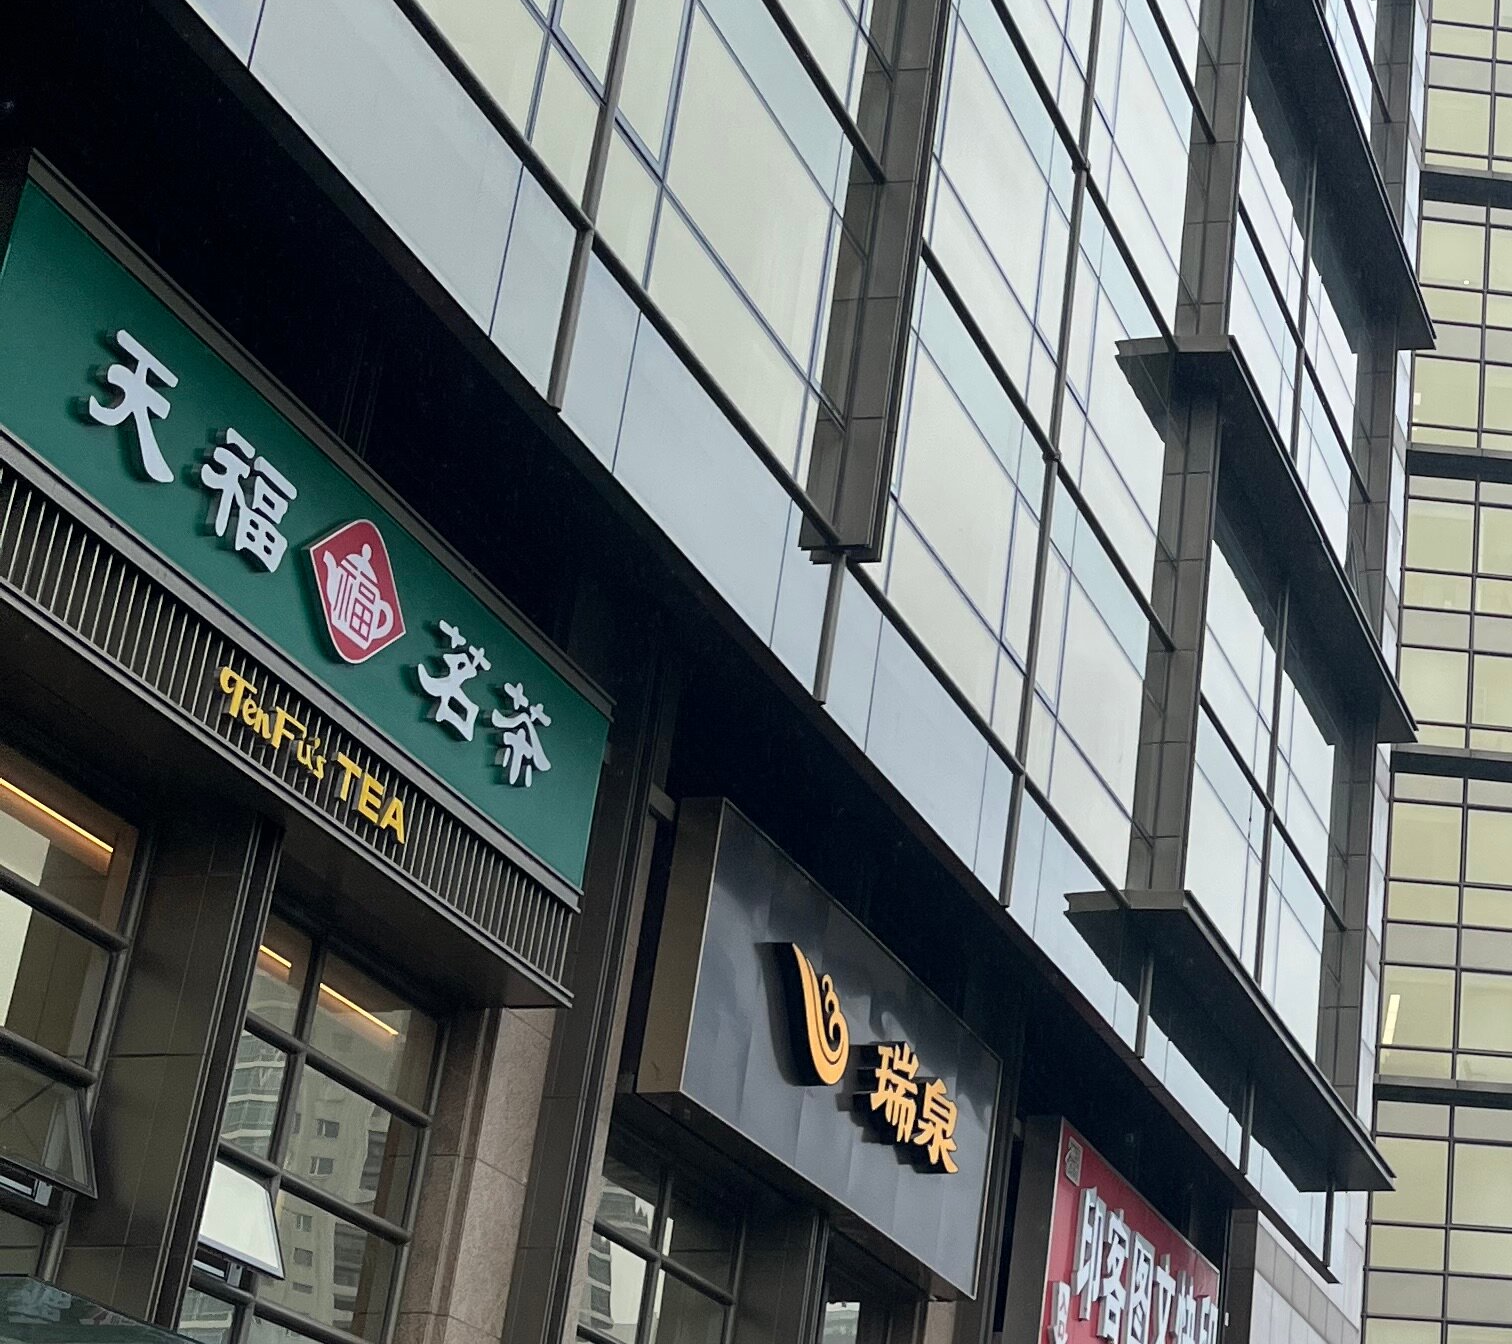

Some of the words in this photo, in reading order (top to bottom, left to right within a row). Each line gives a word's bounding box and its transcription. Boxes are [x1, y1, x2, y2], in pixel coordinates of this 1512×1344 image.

[88, 329, 297, 573] 天福
[417, 619, 552, 787] 茗茶
[337, 751, 406, 844] TEA
[871, 1042, 959, 1174] 瑞泉
